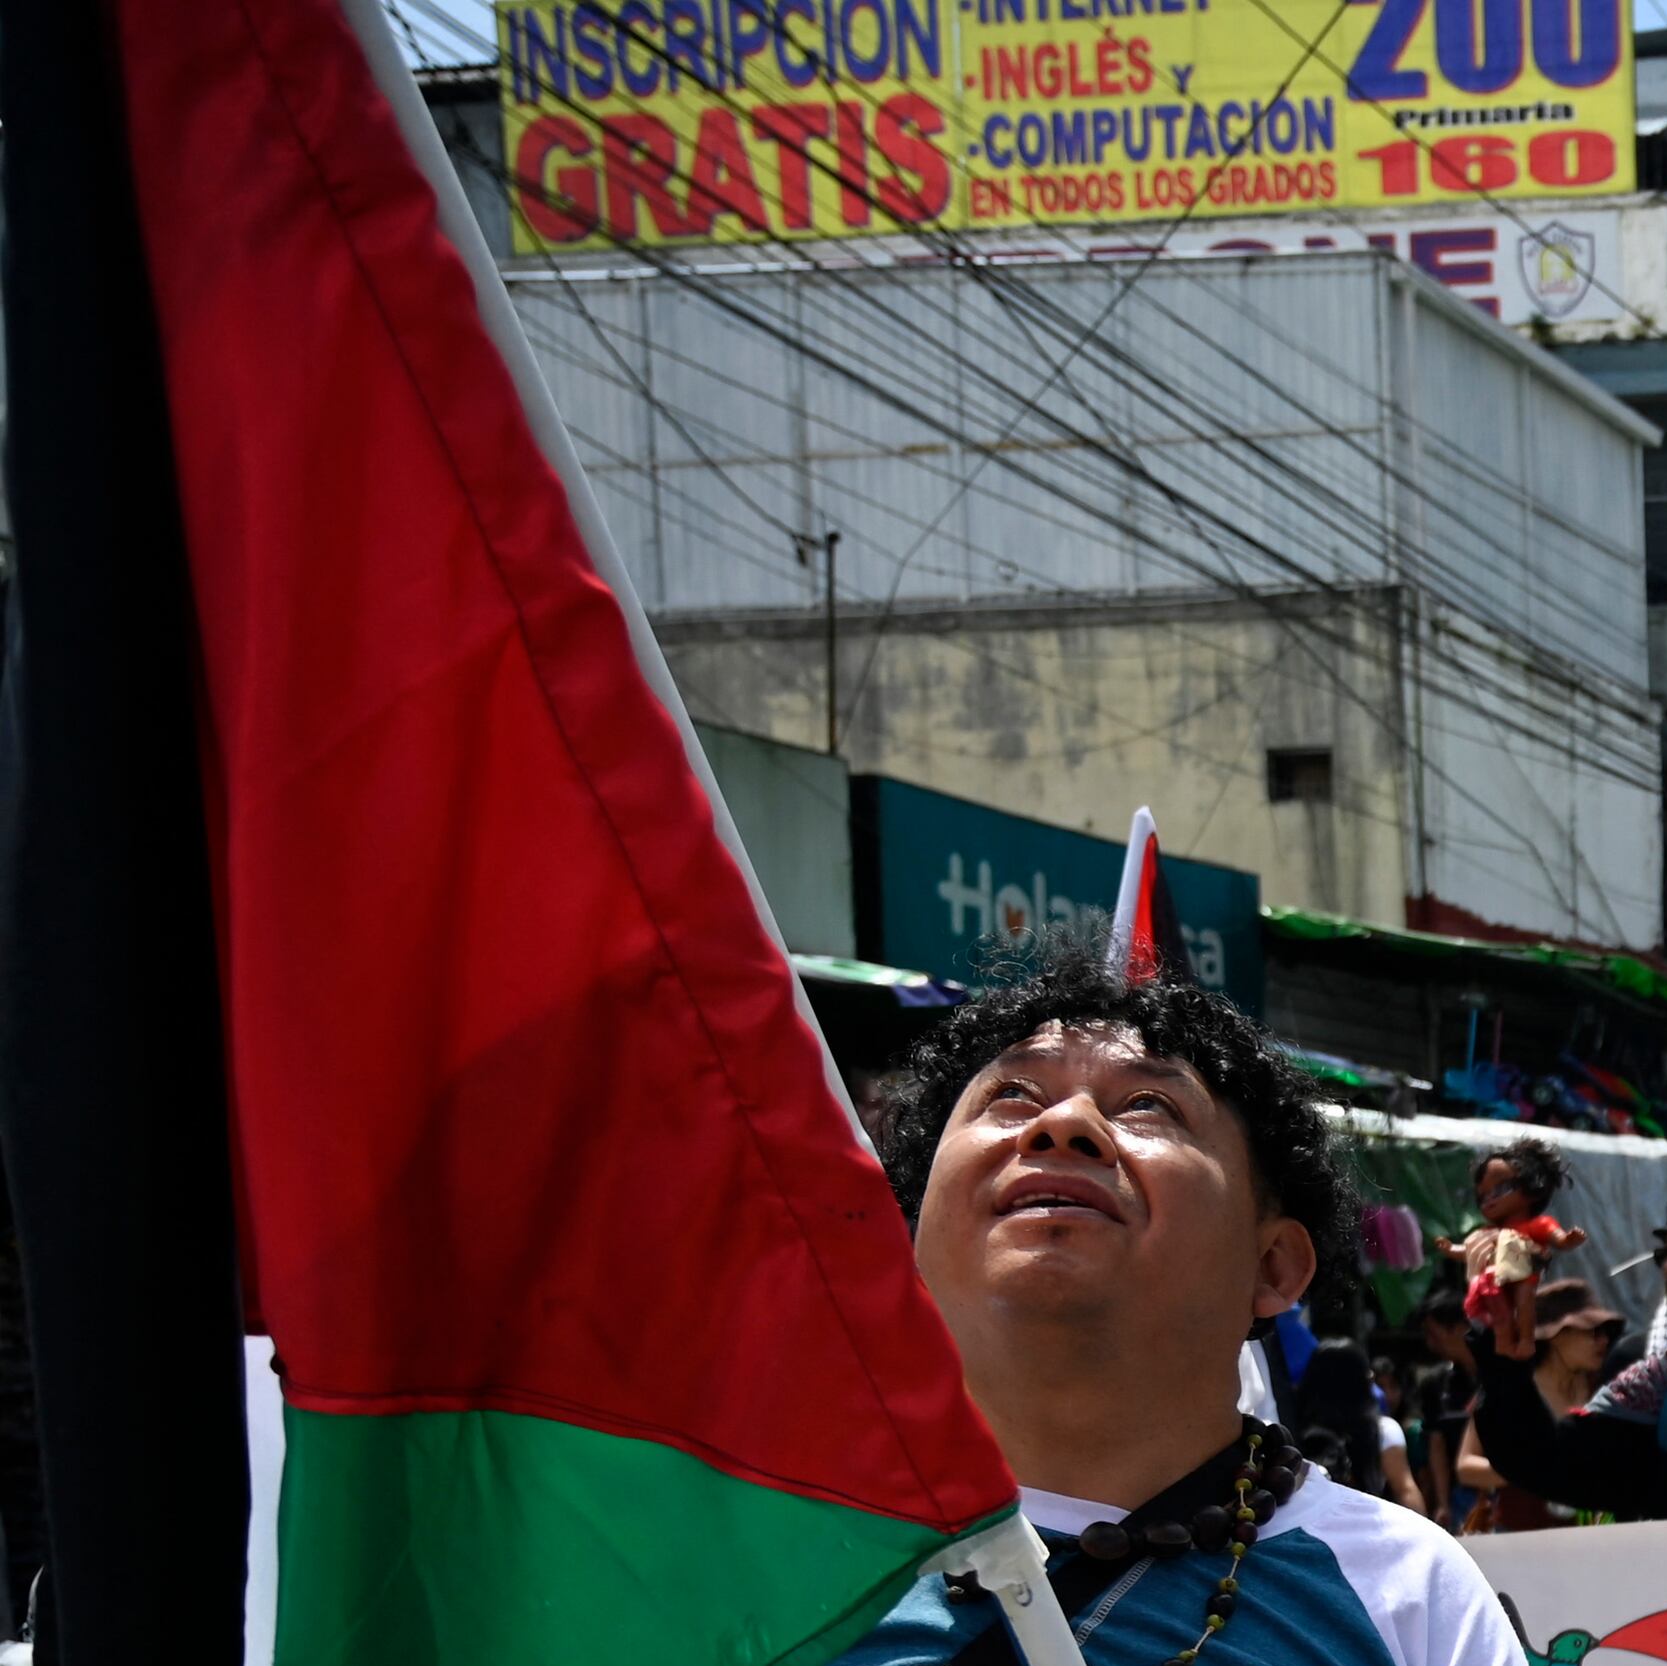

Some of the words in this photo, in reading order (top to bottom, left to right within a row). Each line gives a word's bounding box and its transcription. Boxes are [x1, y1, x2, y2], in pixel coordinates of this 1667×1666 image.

[981, 27, 1155, 101] INGLÉS
[1170, 63, 1195, 96] Y
[1348, 0, 1621, 103] 200
[1394, 101, 1574, 130] Primaria
[516, 92, 952, 243] GRATIS
[970, 176, 1012, 219] EN
[1020, 170, 1124, 214] TODOS
[1135, 166, 1196, 210] LOS
[1206, 161, 1337, 207] GRADOS
[1357, 130, 1616, 196] 160
